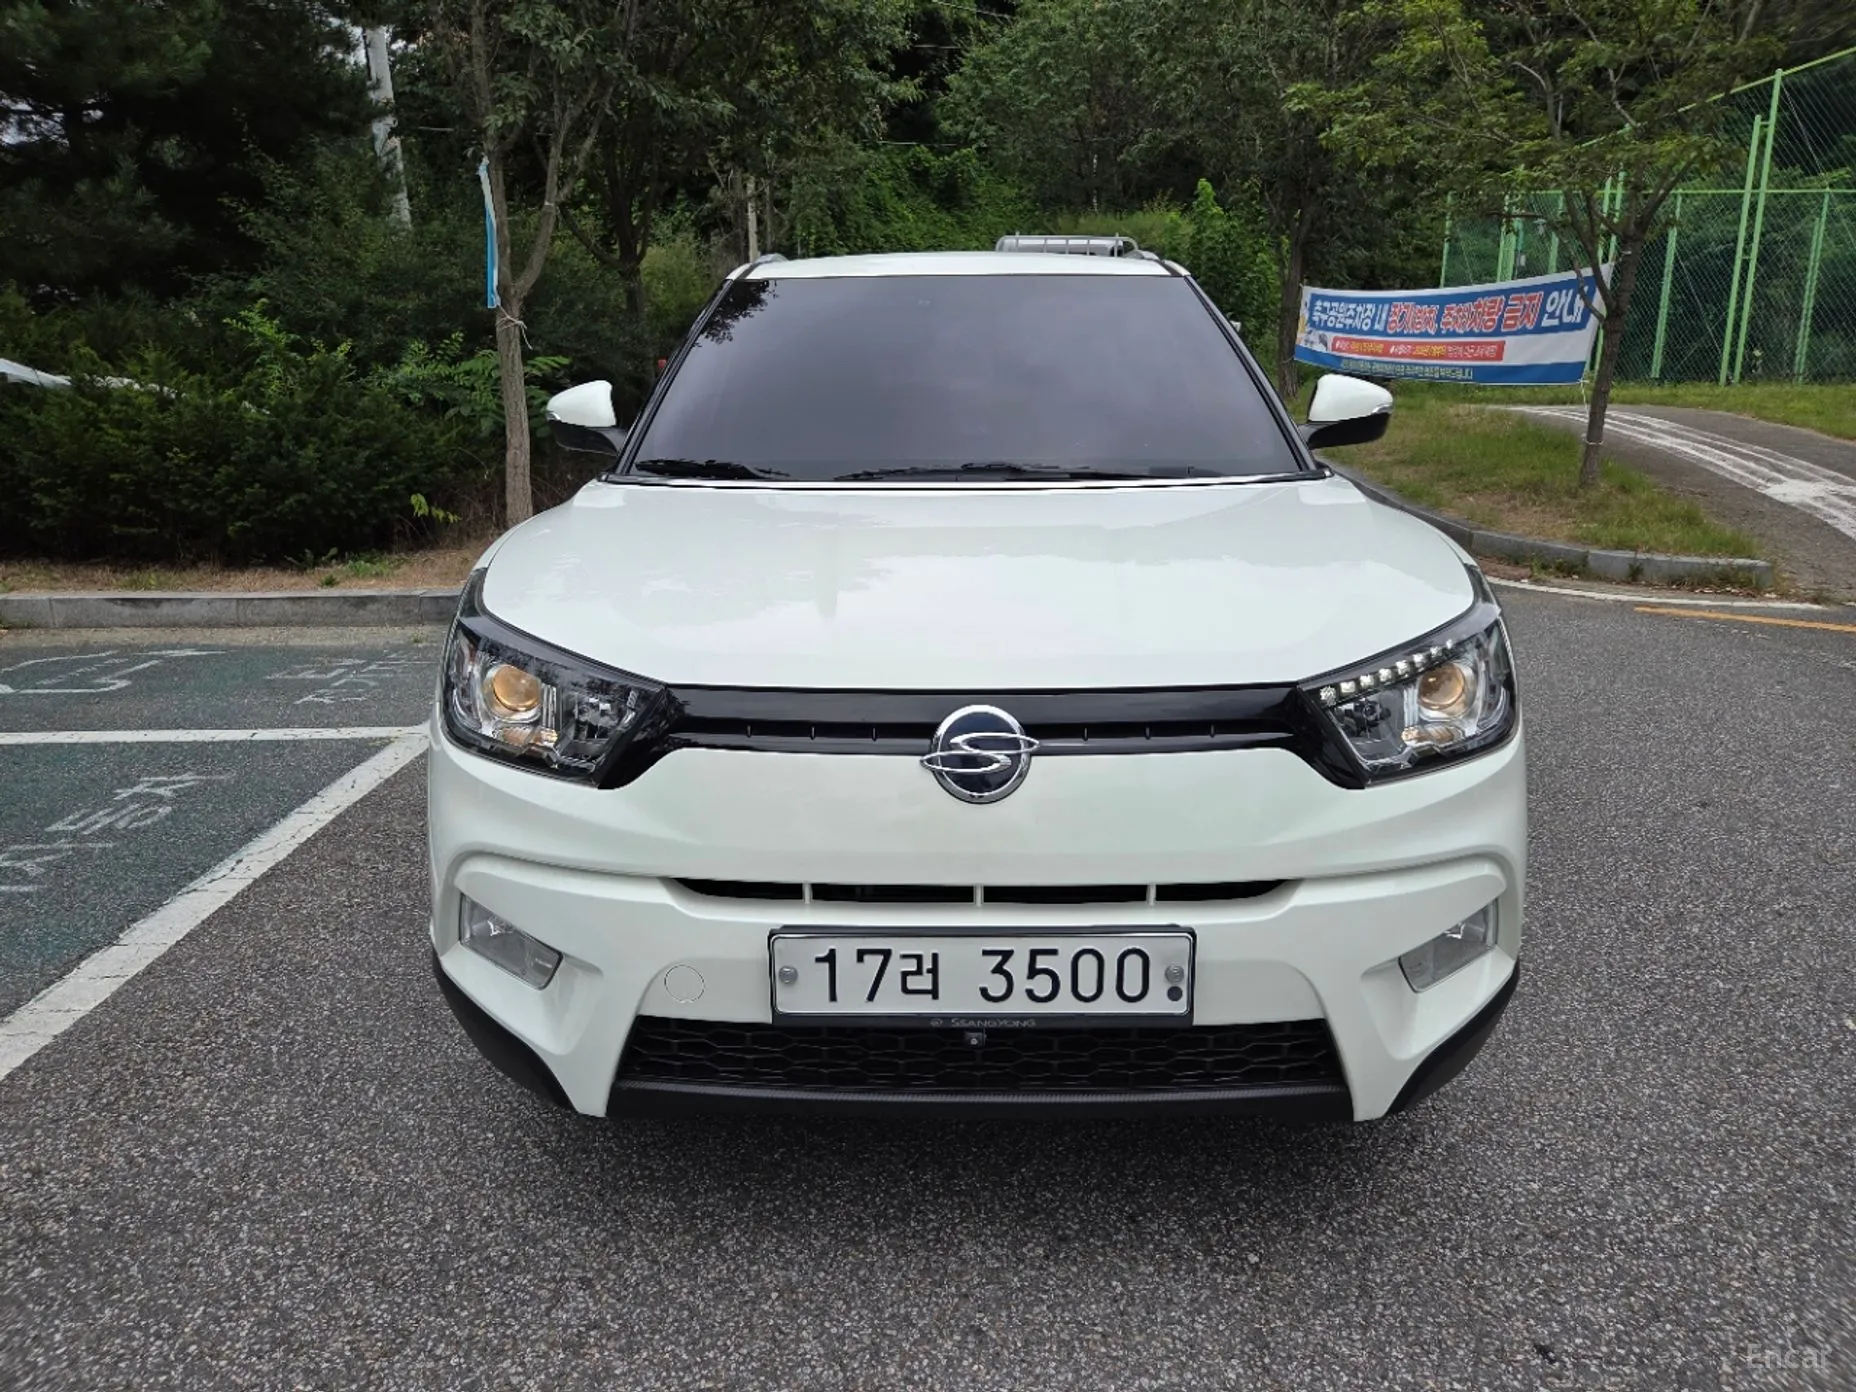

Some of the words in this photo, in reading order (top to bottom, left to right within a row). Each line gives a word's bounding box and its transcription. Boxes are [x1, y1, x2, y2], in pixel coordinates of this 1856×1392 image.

[1373, 303, 1390, 331] 내
[1501, 291, 1544, 332] 금지
[1541, 286, 1588, 327] 안내
[815, 947, 940, 1002] 17러
[978, 947, 1151, 1003] 3500
[951, 1017, 1037, 1028] SSANGYONG
